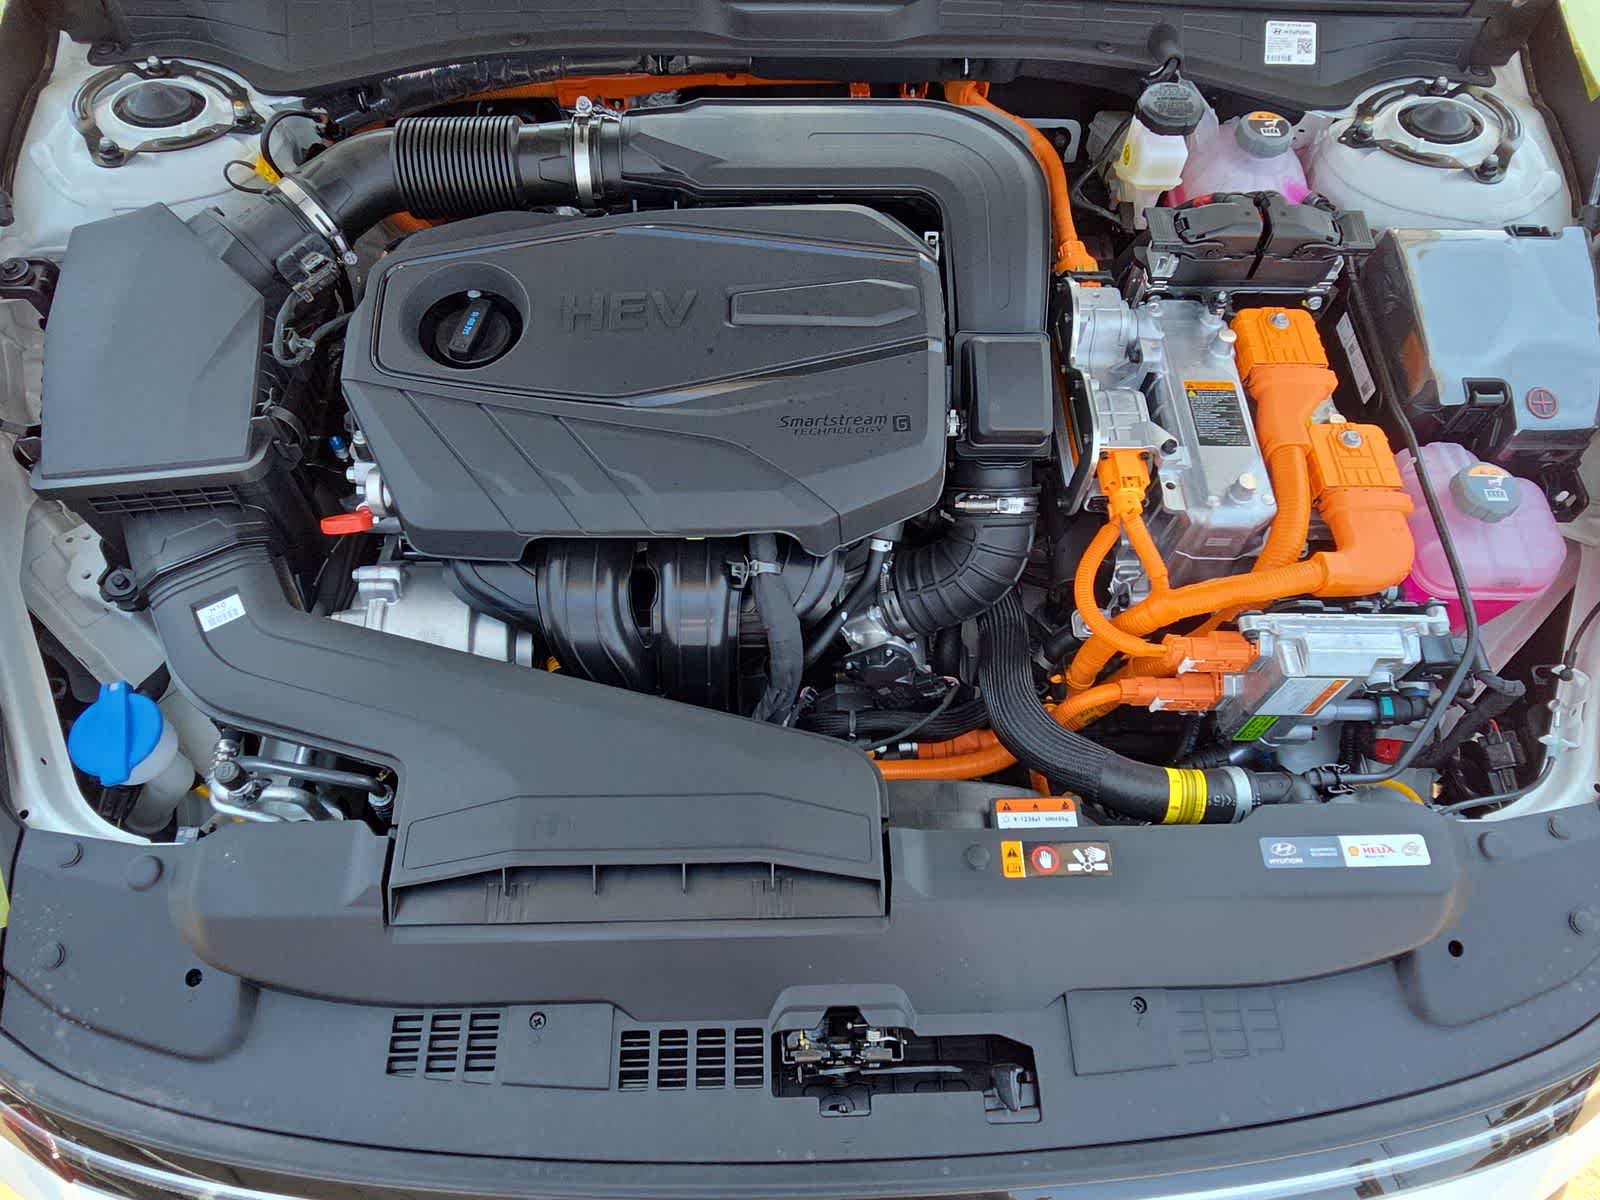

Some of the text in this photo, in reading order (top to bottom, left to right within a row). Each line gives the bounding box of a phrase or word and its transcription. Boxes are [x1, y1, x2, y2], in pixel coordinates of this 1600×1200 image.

[559, 288, 699, 333] HEV
[779, 414, 888, 428] Smartstream
[793, 425, 885, 436] TECHNOLOGY
